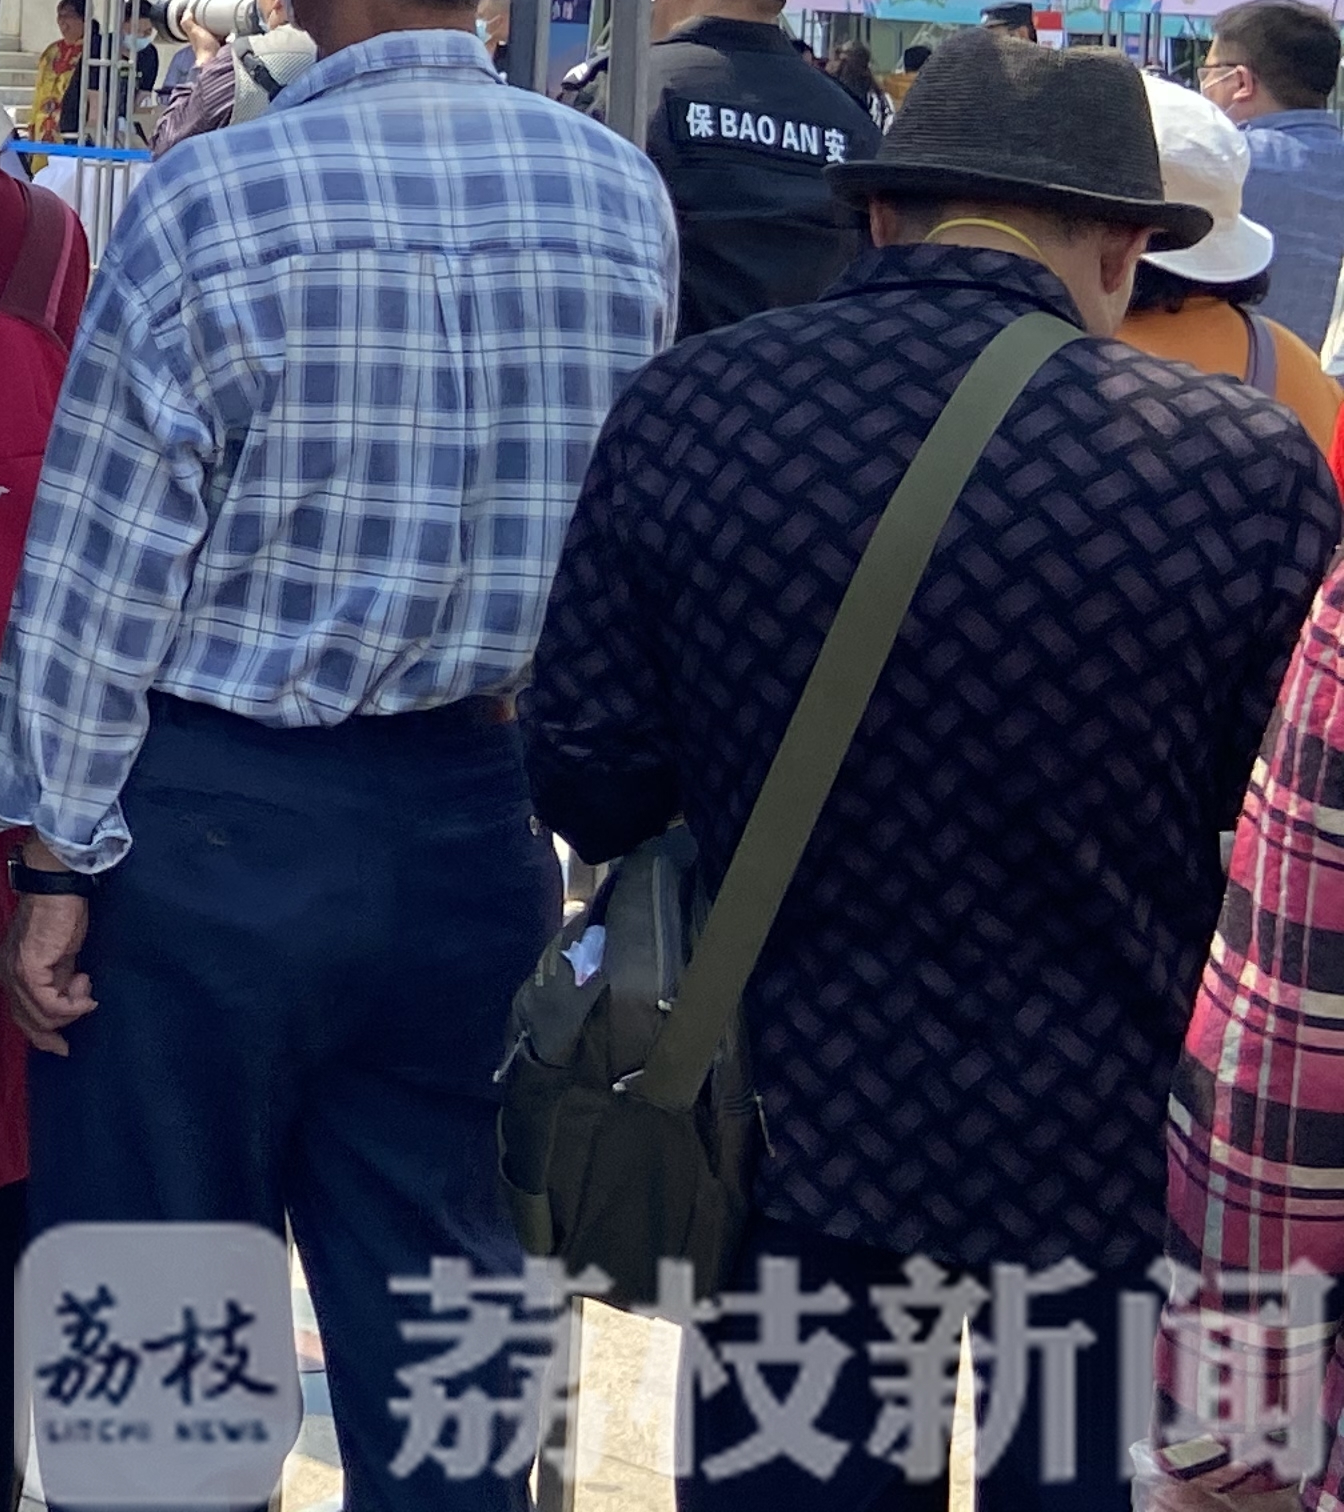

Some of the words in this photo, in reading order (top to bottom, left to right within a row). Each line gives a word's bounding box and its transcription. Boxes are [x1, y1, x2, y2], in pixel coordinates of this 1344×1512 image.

[685, 101, 714, 138] 保
[719, 107, 777, 146] BAO
[781, 119, 819, 155] AN
[823, 127, 848, 165] 安
